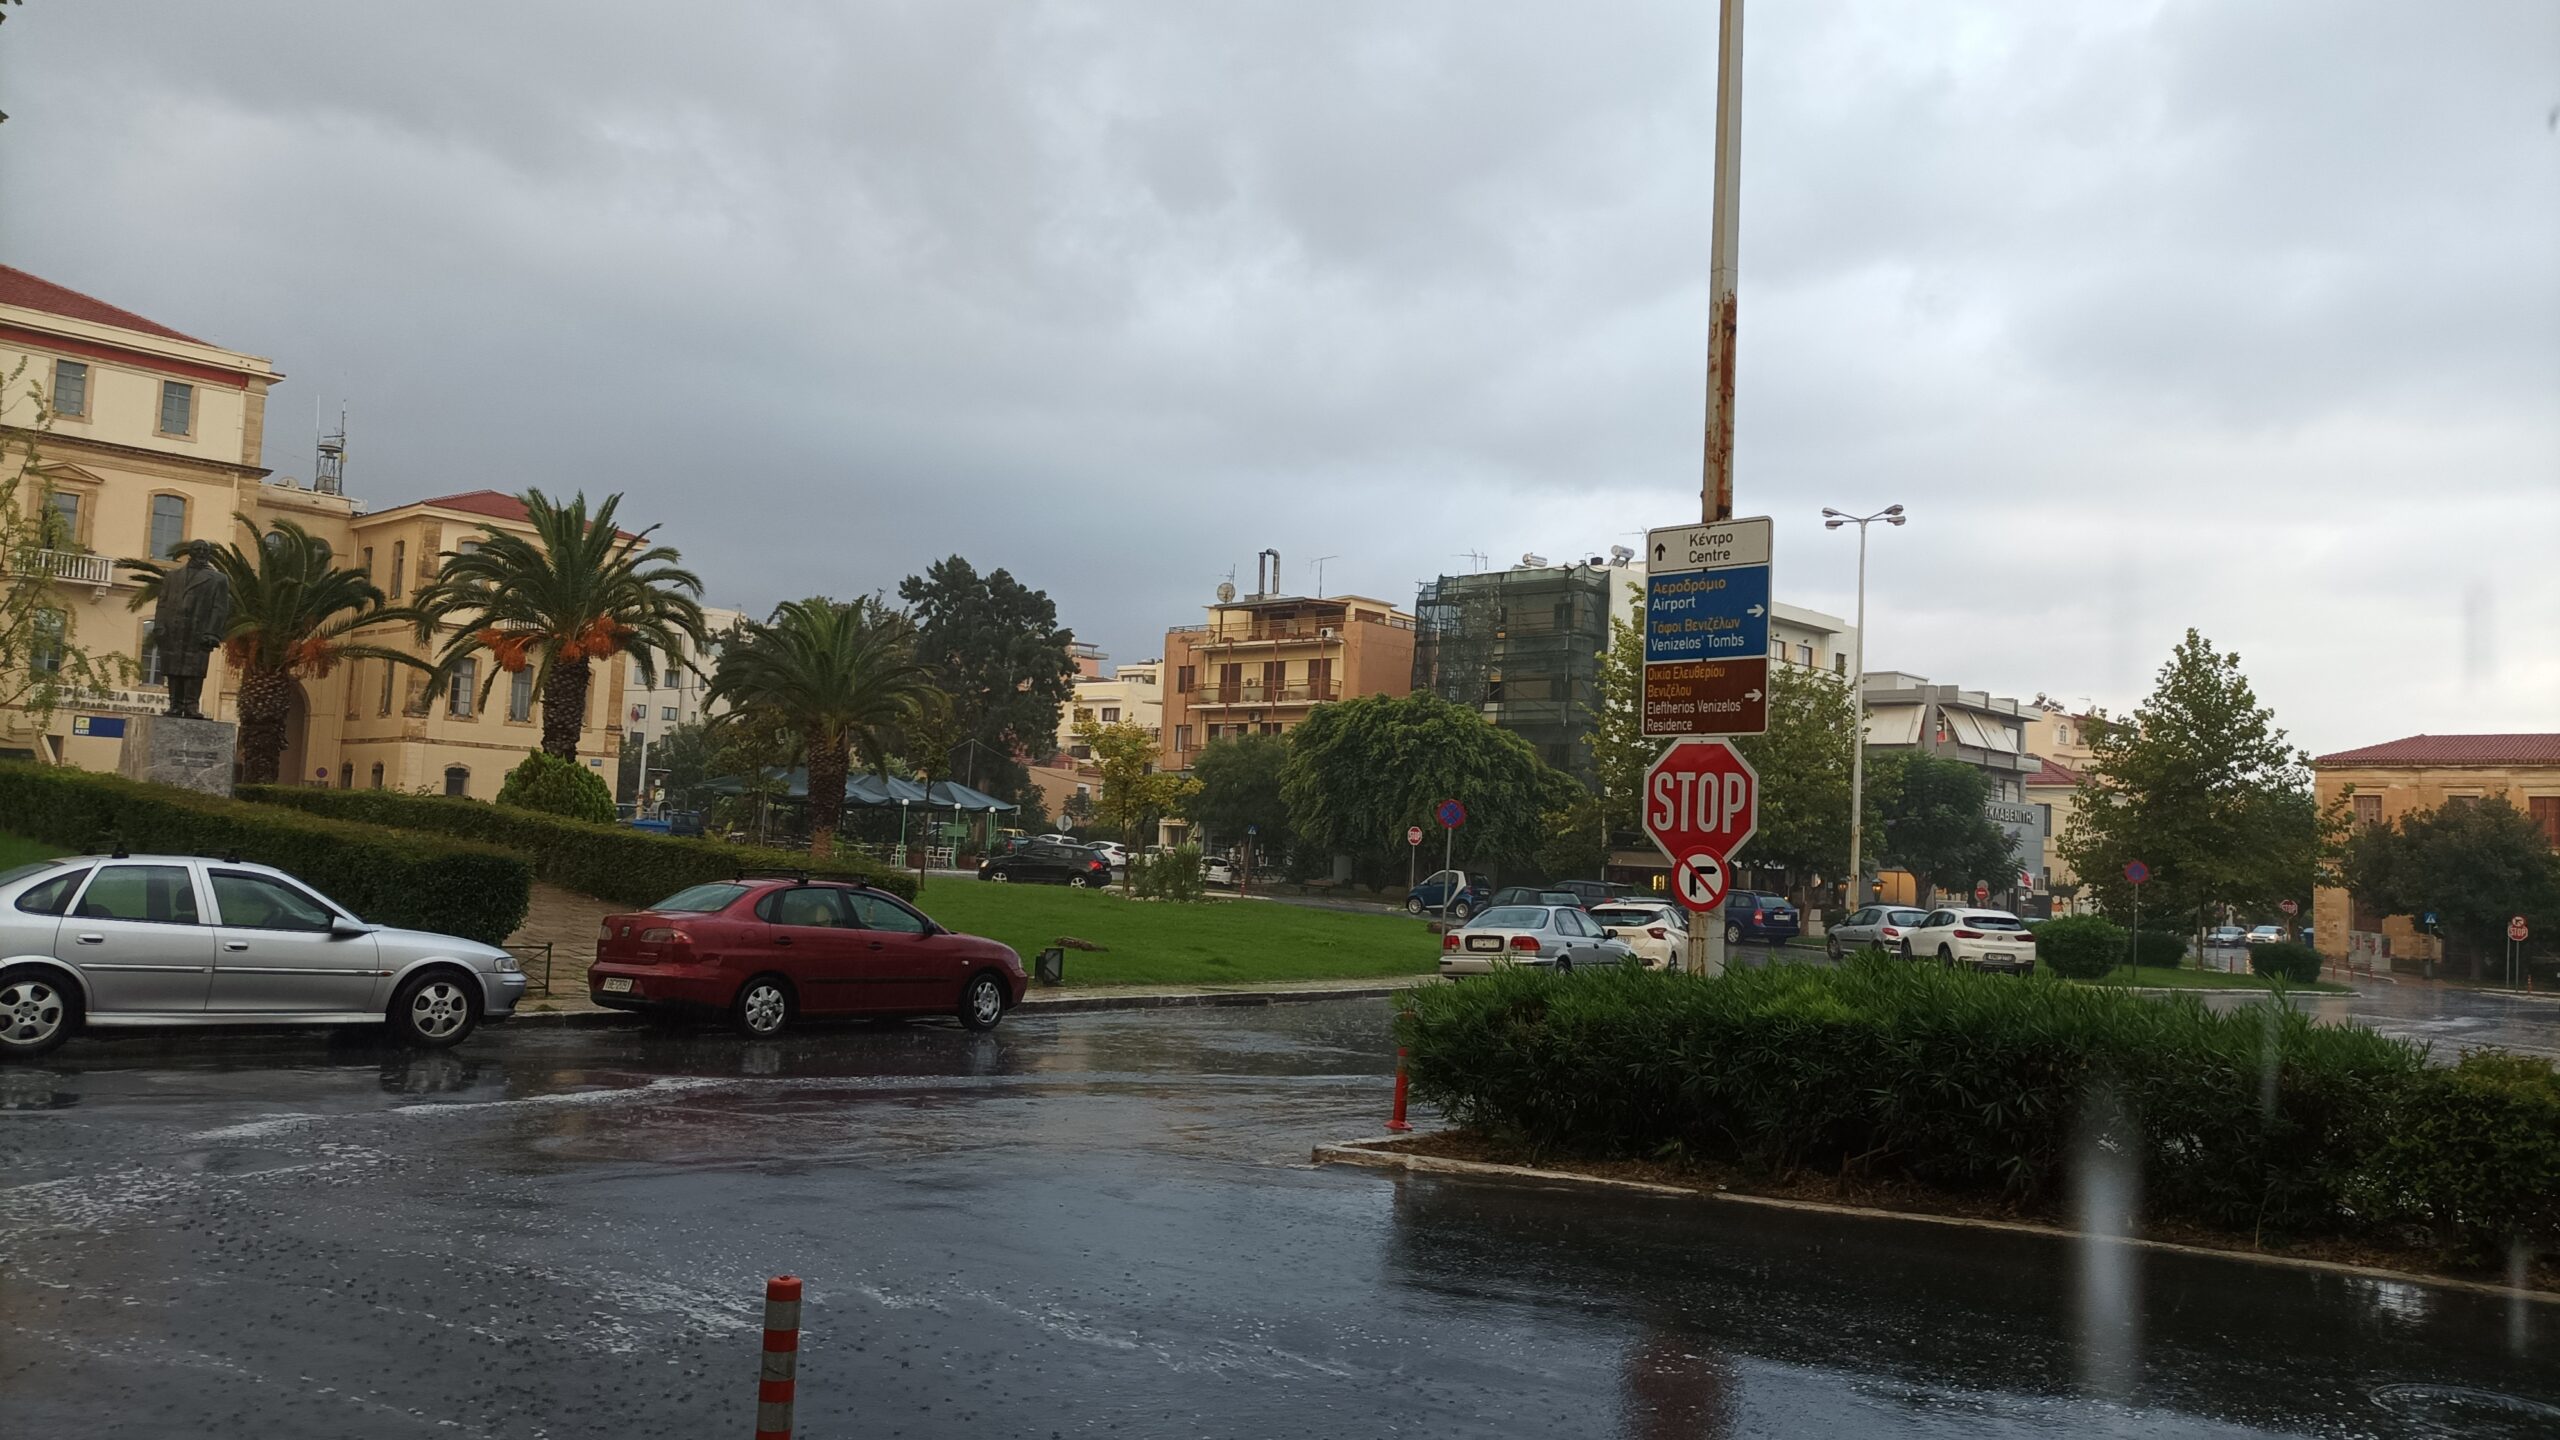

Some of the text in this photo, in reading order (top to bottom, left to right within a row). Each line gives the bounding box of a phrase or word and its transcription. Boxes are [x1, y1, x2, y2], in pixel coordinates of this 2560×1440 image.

[1689, 532, 1733, 548] Κέντρο
[1689, 549, 1731, 564] Centre
[1652, 577, 1727, 596] Αεροδρόμιο
[1651, 596, 1696, 613] Airport
[1707, 633, 1745, 649] Tombs
[1647, 684, 1692, 700] Βενιζέλου
[1647, 700, 1695, 715] Eleftherios
[1646, 718, 1693, 732] Residence
[1653, 771, 1746, 834] STOP
[2510, 927, 2526, 937] STOP
